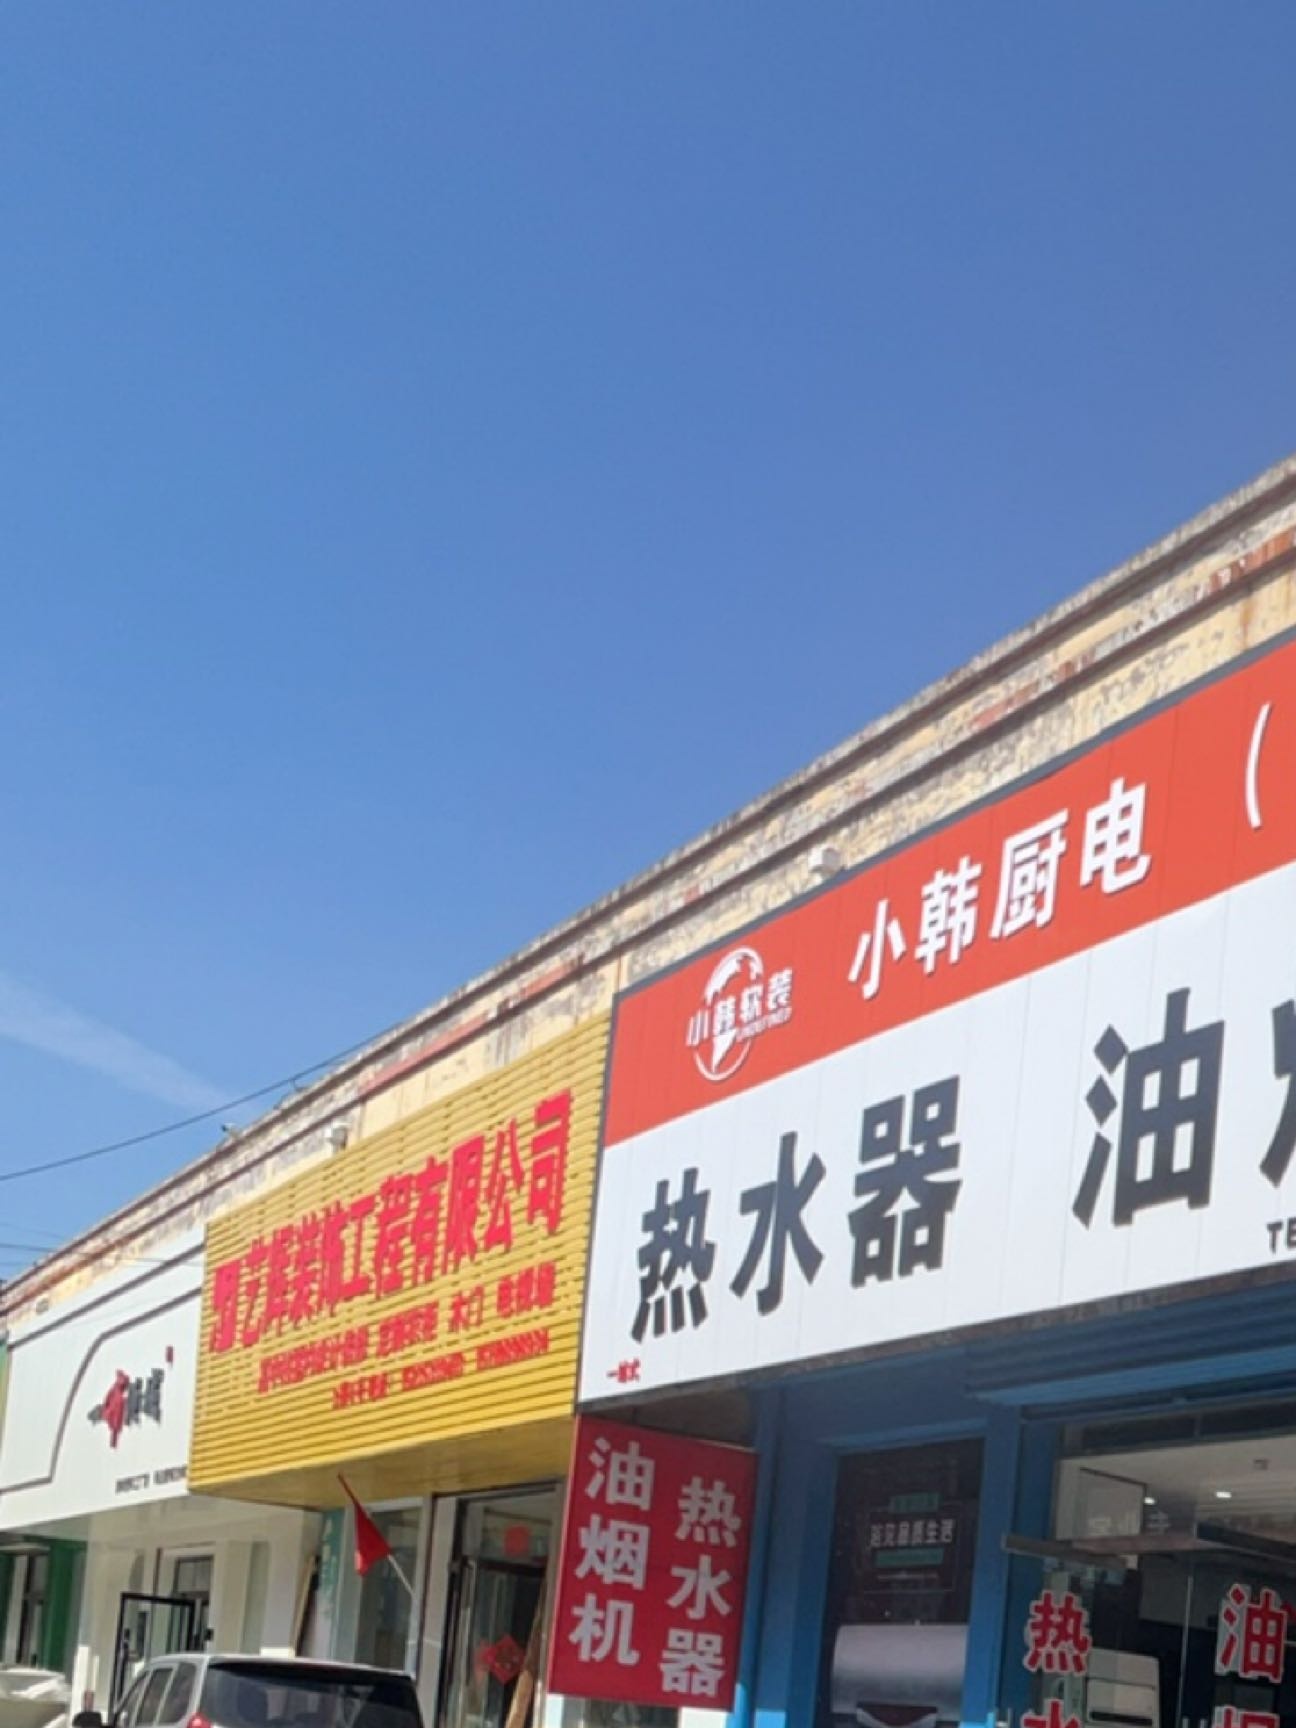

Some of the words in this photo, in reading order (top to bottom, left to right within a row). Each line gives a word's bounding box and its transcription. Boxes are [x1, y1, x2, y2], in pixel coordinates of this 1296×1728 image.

[848, 777, 1151, 1000] 小韩厨电
[631, 1075, 961, 1342] 热水器
[568, 1436, 656, 1667] 油烟机
[659, 1475, 741, 1697] 热水器
